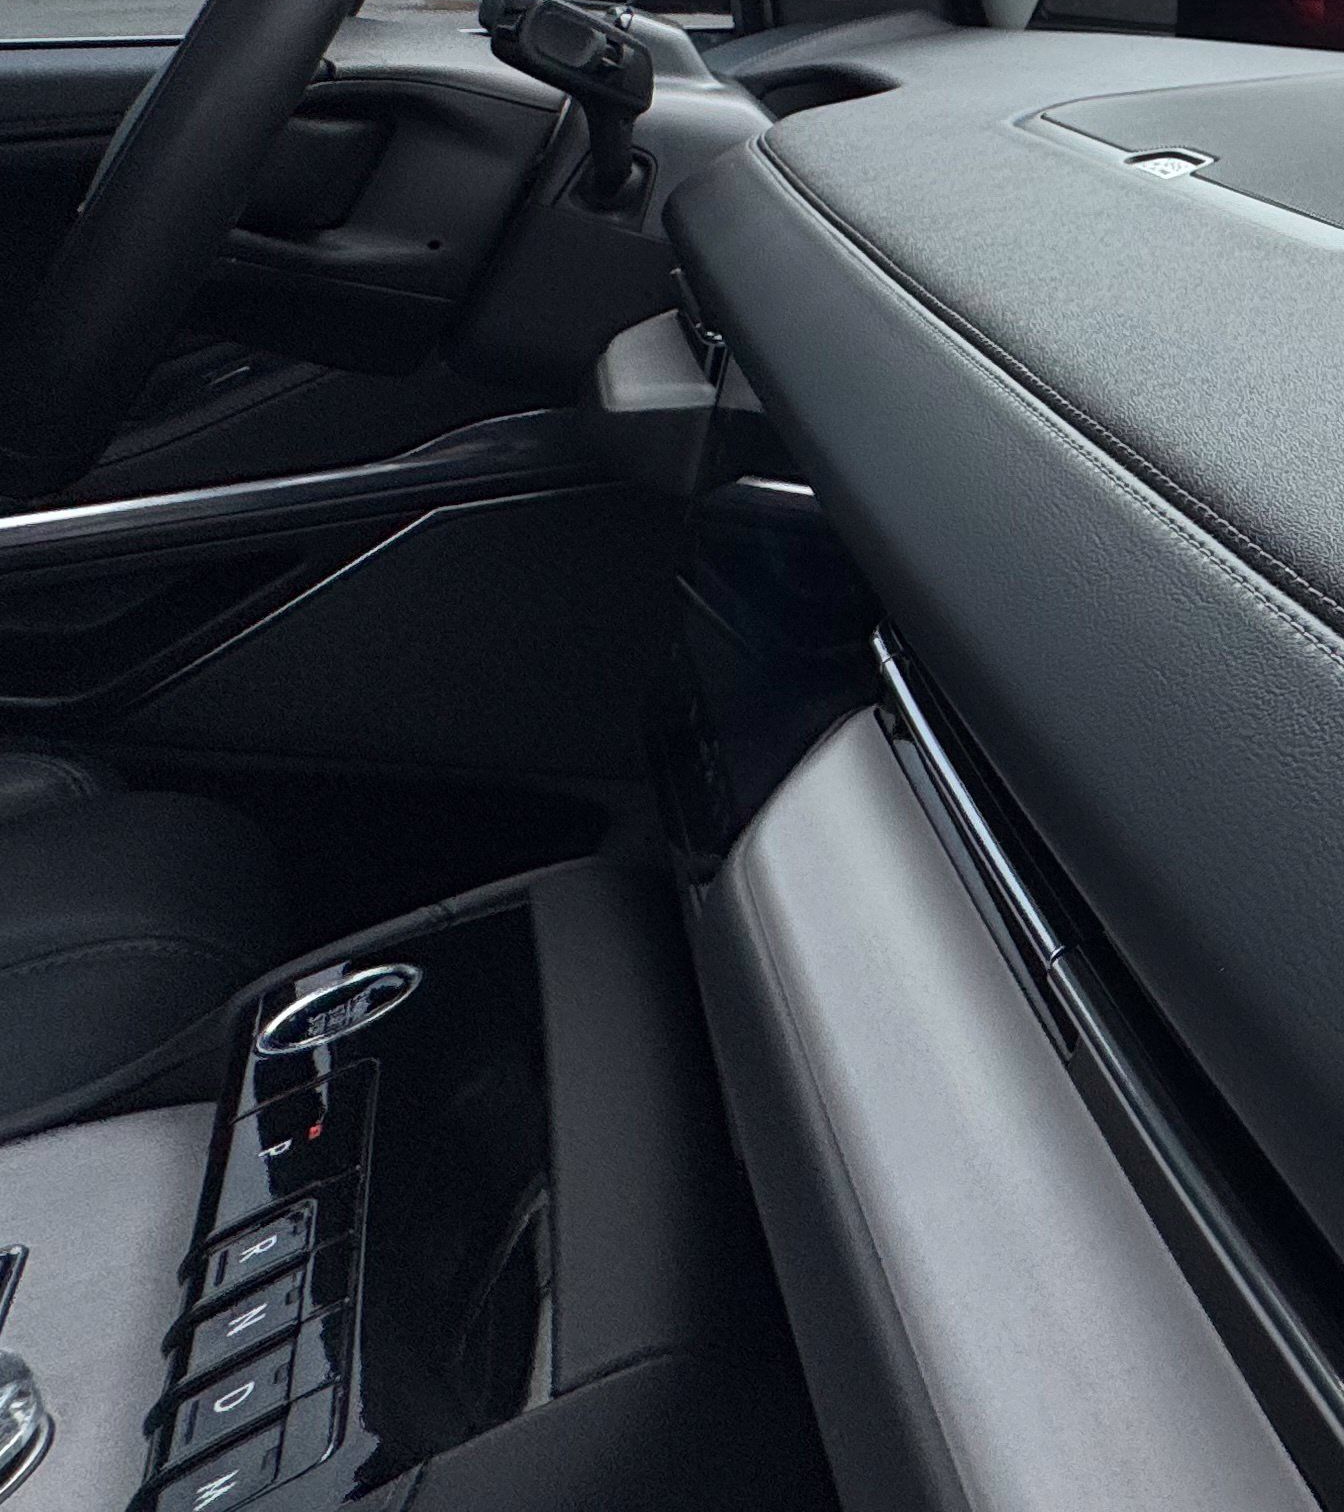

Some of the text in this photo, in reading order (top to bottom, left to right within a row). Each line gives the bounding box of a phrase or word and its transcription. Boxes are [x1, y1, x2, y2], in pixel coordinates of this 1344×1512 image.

[258, 1138, 293, 1157] P
[238, 1234, 277, 1263] R
[226, 1303, 268, 1337] N
[213, 1381, 255, 1413] D
[193, 1468, 240, 1511] M
